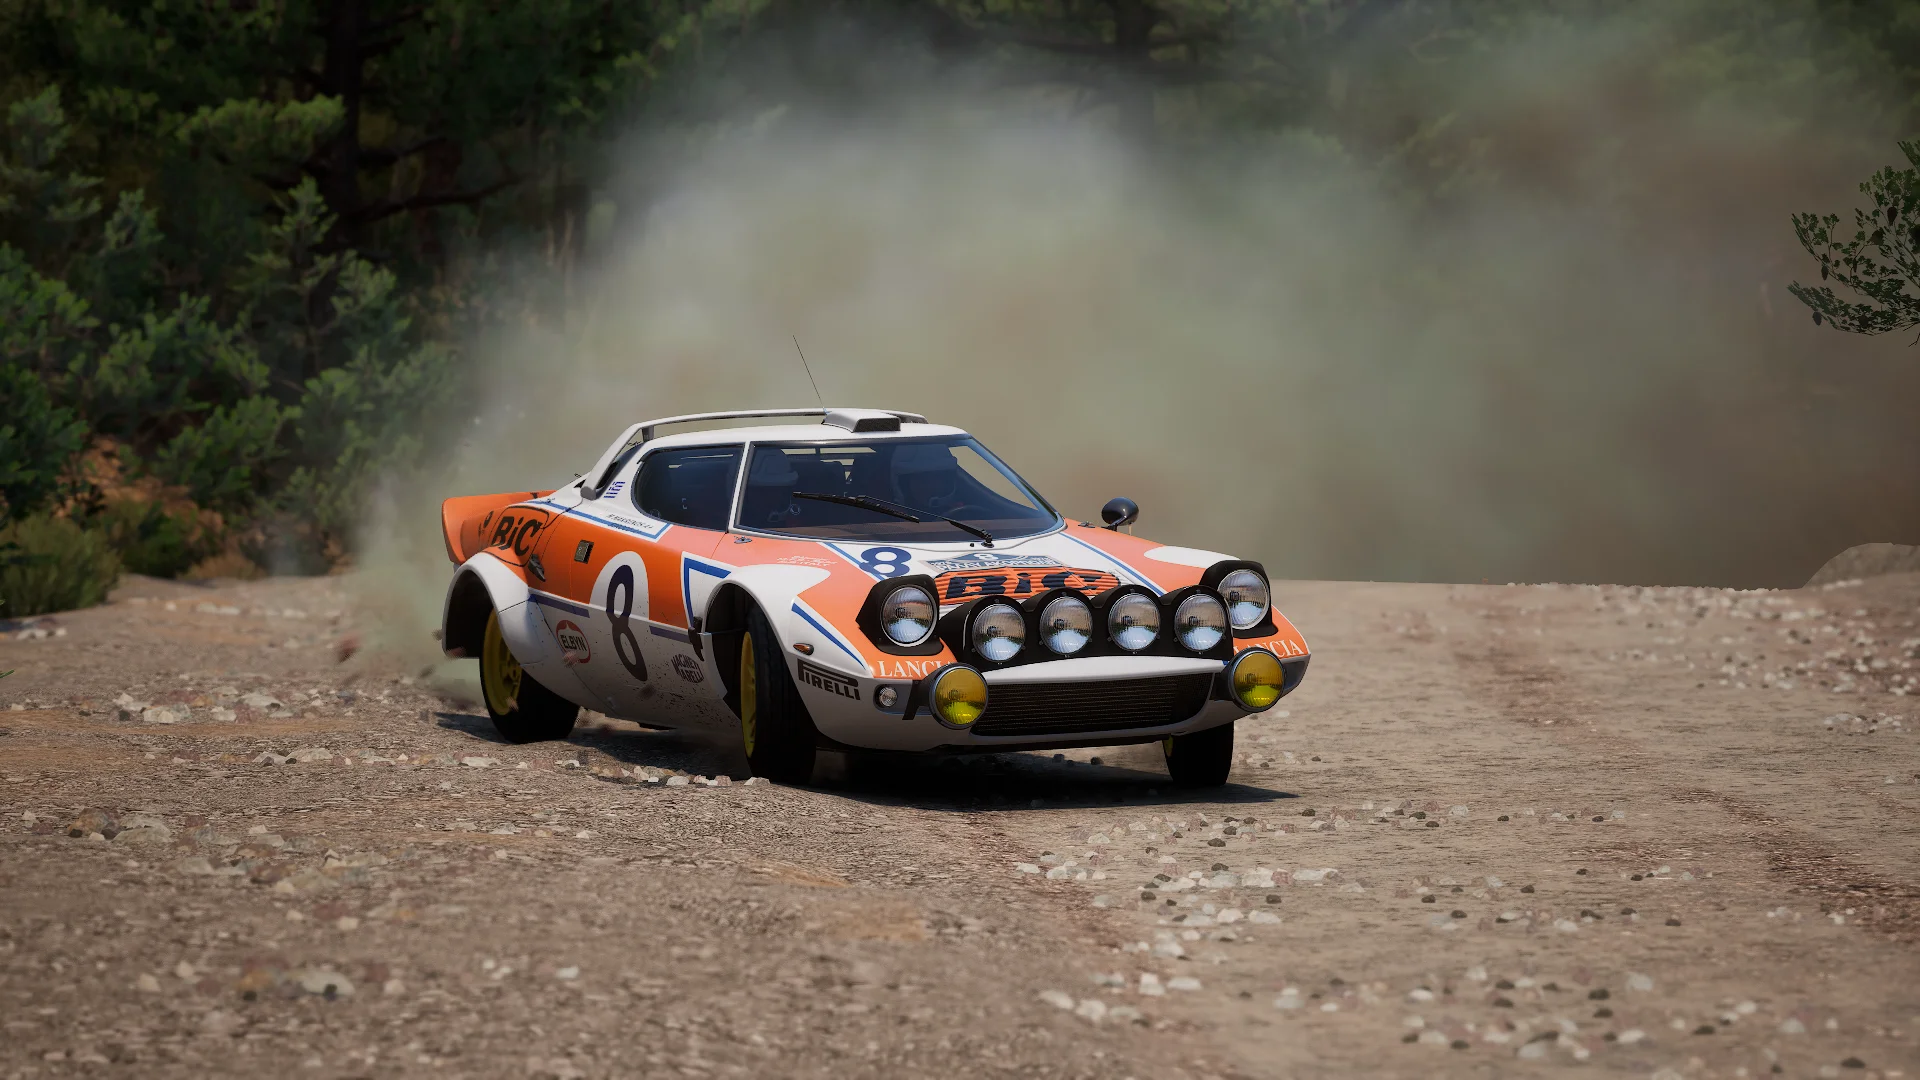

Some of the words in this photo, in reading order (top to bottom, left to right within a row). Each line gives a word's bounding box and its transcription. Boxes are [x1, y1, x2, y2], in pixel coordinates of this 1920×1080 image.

[490, 516, 543, 557] BiC
[859, 547, 912, 577] 8
[974, 553, 999, 561] 8
[945, 572, 1103, 599] BiC
[606, 565, 648, 682] 8
[1233, 640, 1305, 658] CIA
[797, 658, 861, 700] PIRELLI
[877, 660, 952, 678] LANC
